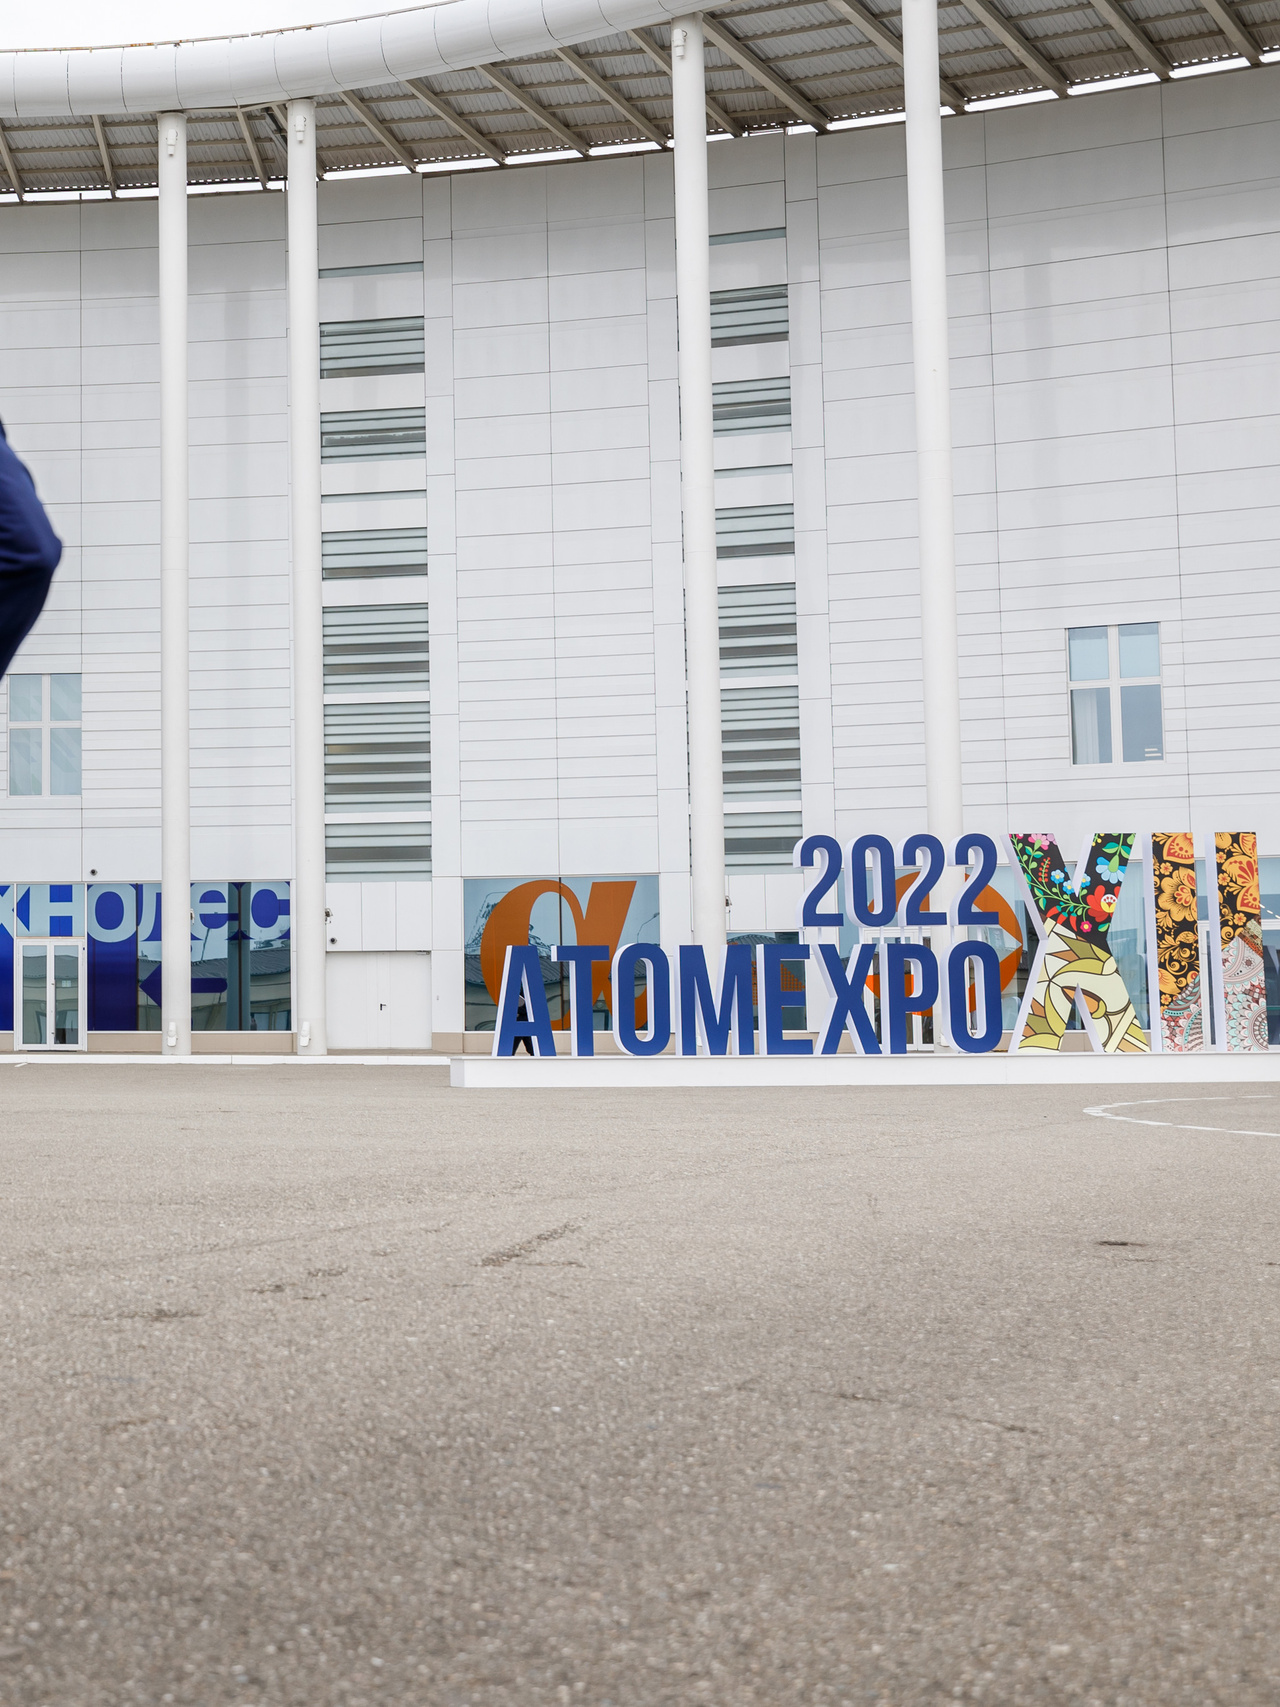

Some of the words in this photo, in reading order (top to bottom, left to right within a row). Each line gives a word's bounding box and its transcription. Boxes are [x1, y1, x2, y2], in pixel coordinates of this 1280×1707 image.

[793, 833, 1000, 928] 2022
[491, 940, 1004, 1057] ATOMEXPO
[1005, 831, 1270, 1054] XII
